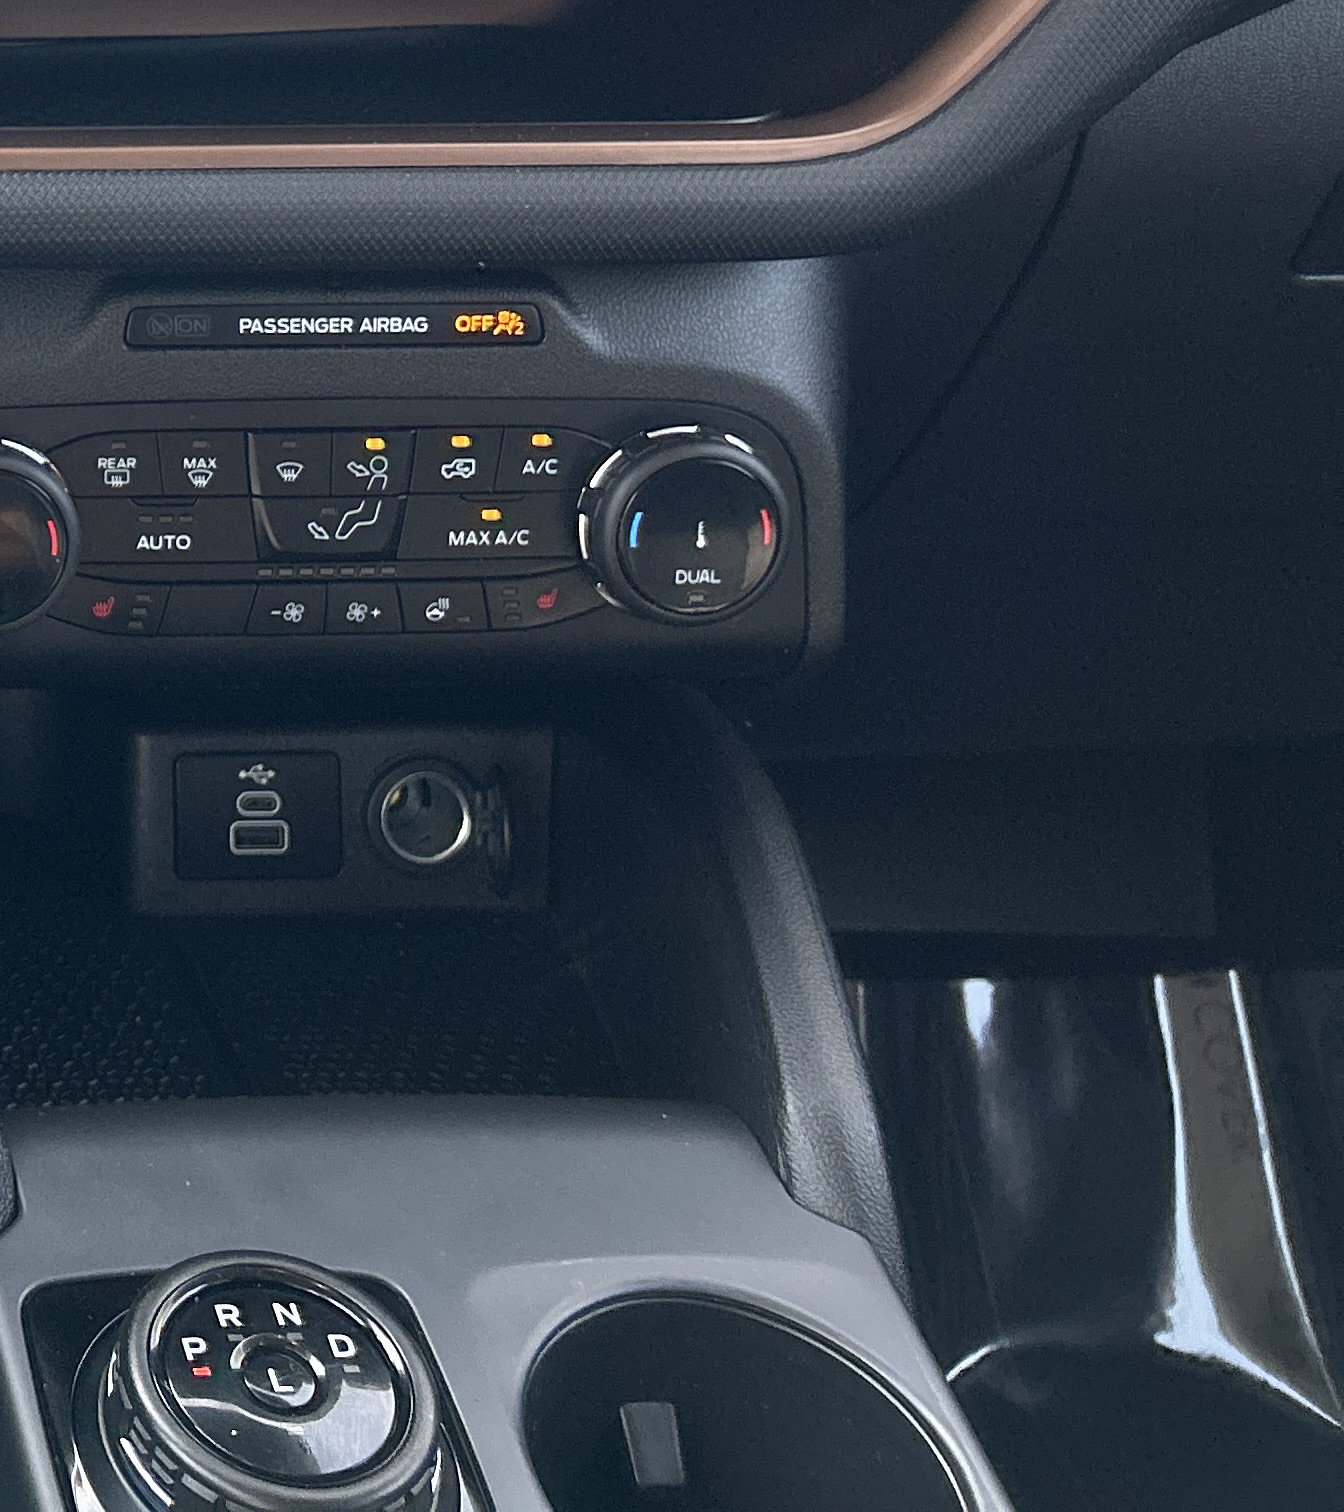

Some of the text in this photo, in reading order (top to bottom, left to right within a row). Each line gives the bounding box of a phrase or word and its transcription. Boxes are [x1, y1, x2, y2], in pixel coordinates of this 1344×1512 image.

[240, 315, 494, 333] PASSENGER AIRBAG OFF
[98, 458, 136, 471] REAR
[184, 458, 216, 472] MAX
[523, 459, 557, 474] A/C
[137, 535, 190, 550] AUTO
[449, 530, 529, 545] MAX A/C
[676, 569, 720, 584] DUAL
[214, 1304, 243, 1327] R
[272, 1303, 302, 1325] N
[182, 1337, 206, 1361] P
[327, 1334, 356, 1357] D
[268, 1368, 295, 1392] L
